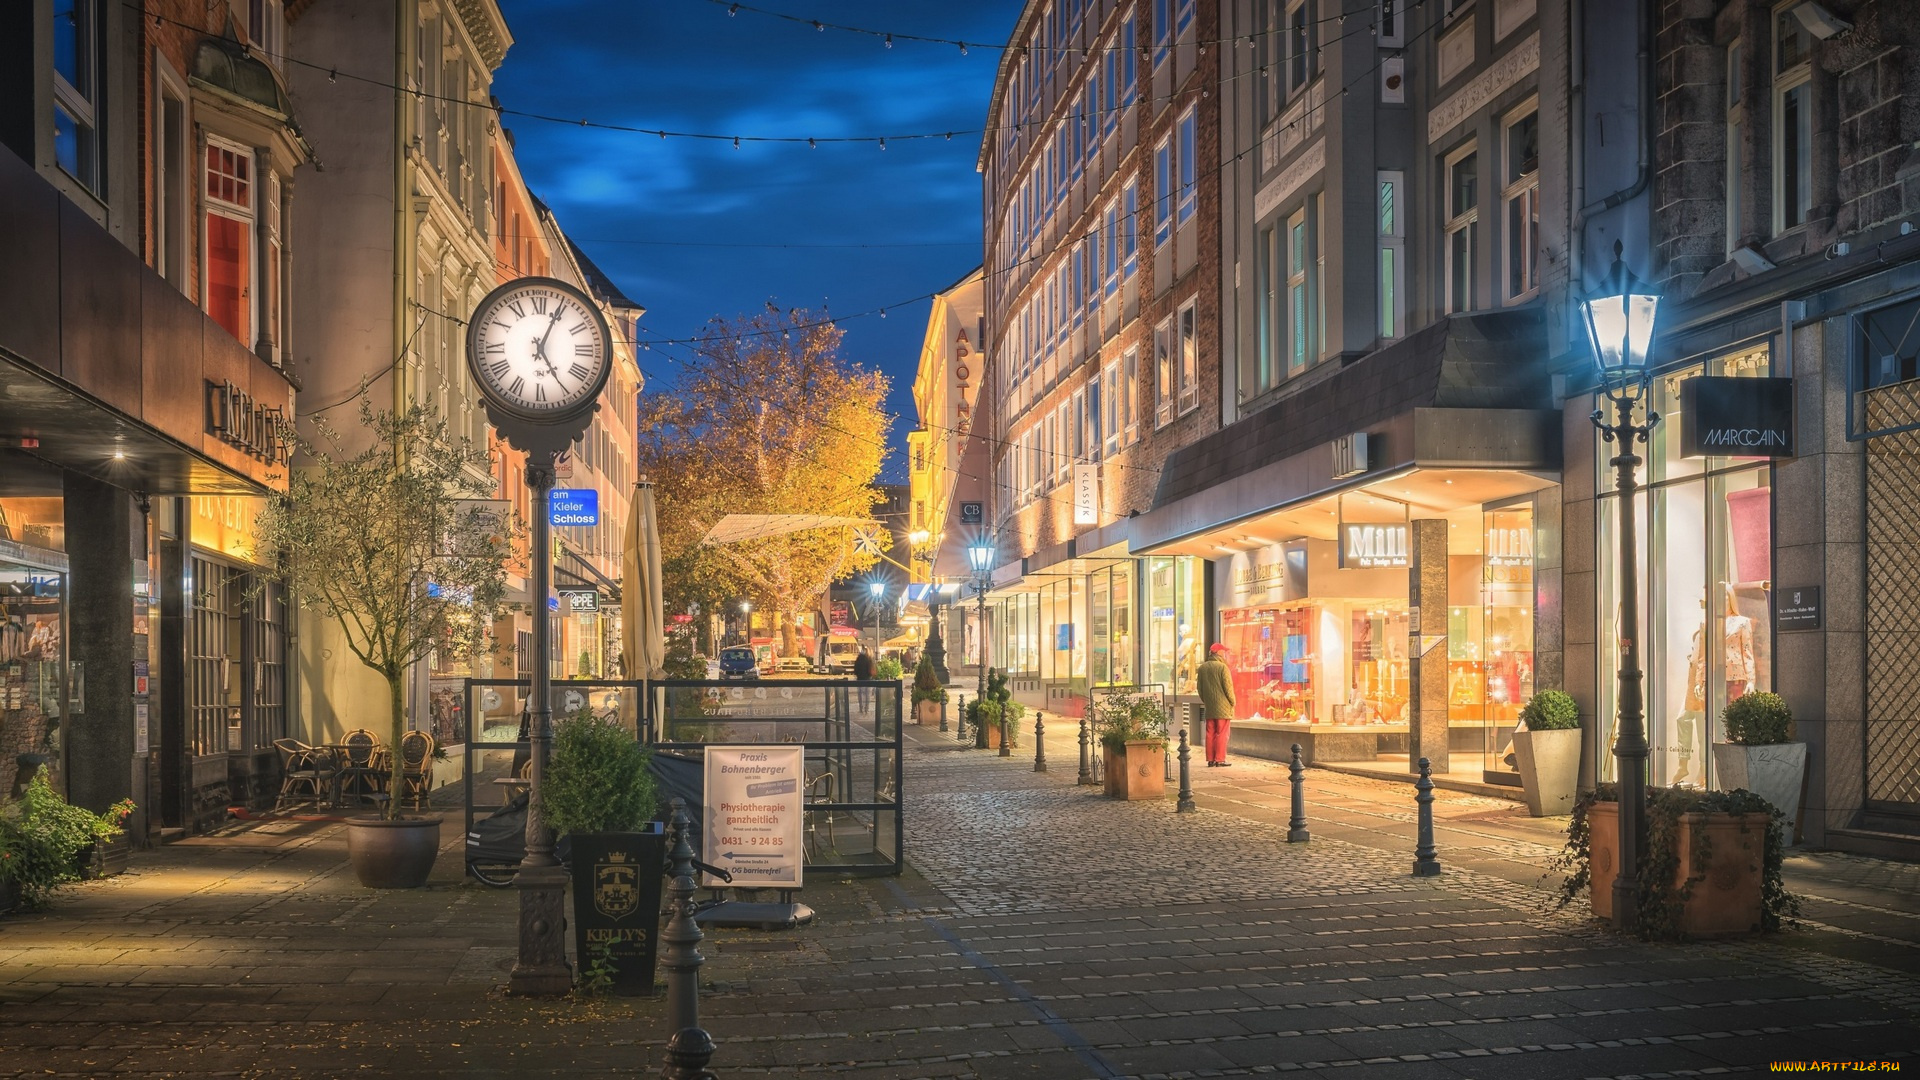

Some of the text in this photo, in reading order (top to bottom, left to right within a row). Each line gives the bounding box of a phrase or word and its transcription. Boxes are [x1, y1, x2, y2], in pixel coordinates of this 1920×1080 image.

[552, 490, 569, 499] am
[1082, 472, 1090, 516] KLASSIK
[553, 502, 584, 512] Kieler
[964, 504, 980, 515] CB
[553, 514, 595, 524] Schloss
[1348, 526, 1408, 558] Mill
[740, 753, 768, 762] Praxis
[721, 765, 786, 775] Bohnenberger
[720, 803, 786, 813] Physiotherapie
[726, 815, 779, 825] ganzheitlich
[721, 837, 743, 846] 0431
[751, 837, 757, 846] 9
[759, 837, 770, 846] 24
[772, 837, 783, 846] 85
[743, 867, 781, 876] barrierefrei
